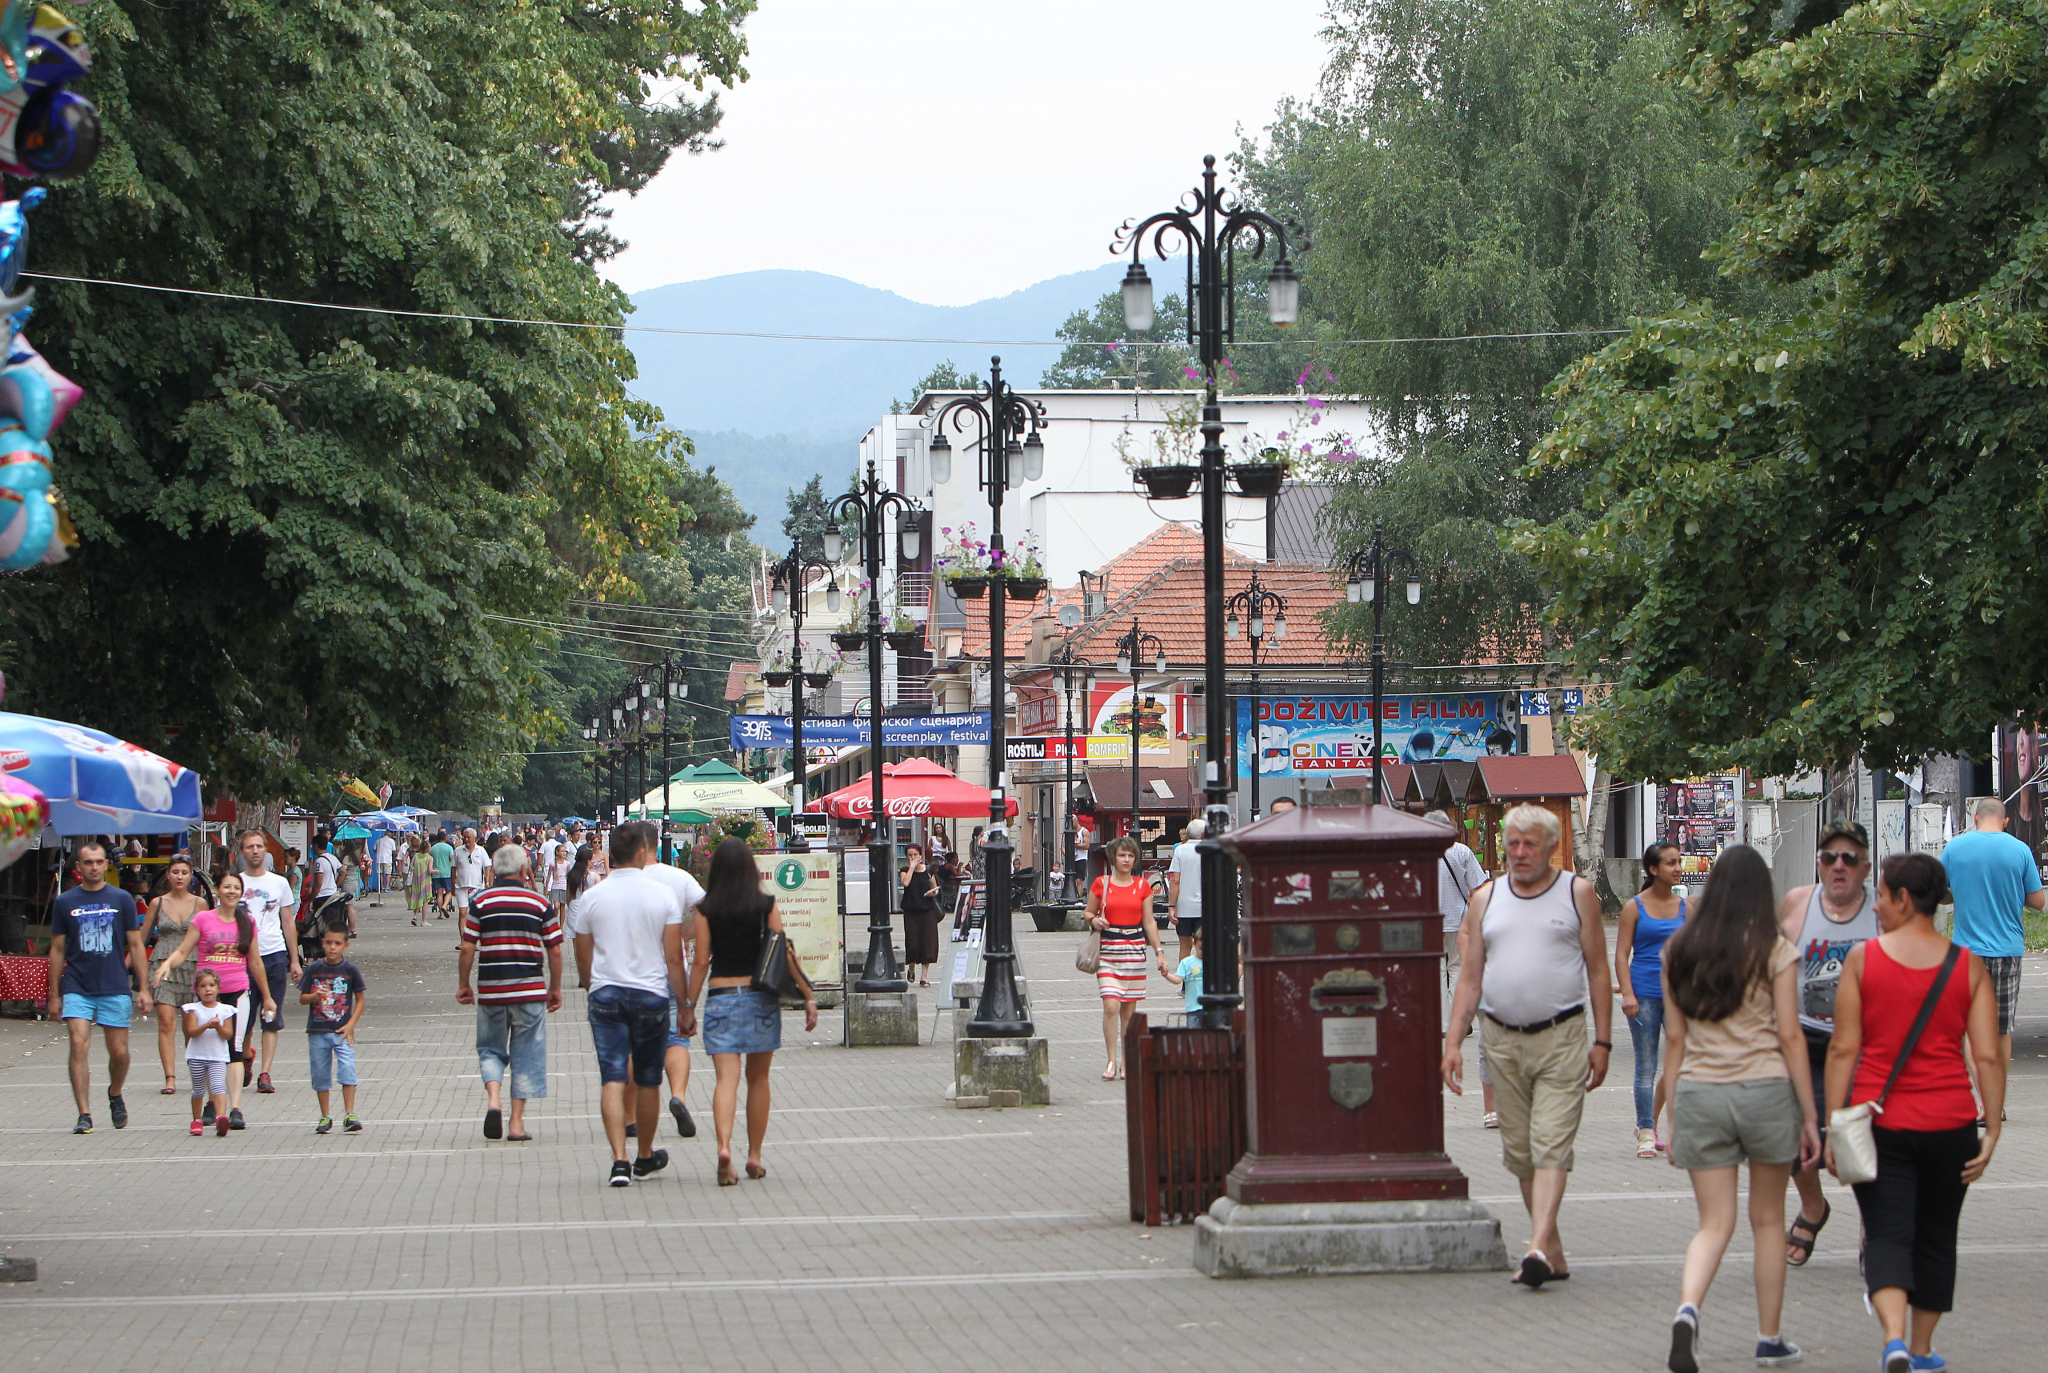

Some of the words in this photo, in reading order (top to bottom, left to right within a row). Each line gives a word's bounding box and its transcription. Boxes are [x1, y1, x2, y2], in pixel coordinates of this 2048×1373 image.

[1259, 697, 1399, 719] DOŽIVITE
[1412, 701, 1484, 719] FILM
[852, 713, 914, 729] фимског
[920, 713, 982, 728] сценарија
[885, 731, 943, 744] screenplay
[950, 730, 989, 741] festival
[1007, 742, 1045, 758] ROŠTILJ
[1055, 743, 1078, 757] PIA
[1088, 743, 1126, 756] POMFRIT
[1293, 743, 1398, 758] CINEMA
[0, 752, 29, 766] kom
[1295, 759, 1398, 768] FANTAY
[795, 896, 828, 905] informacije
[71, 907, 119, 917] Champion
[1807, 938, 1851, 961] HOY
